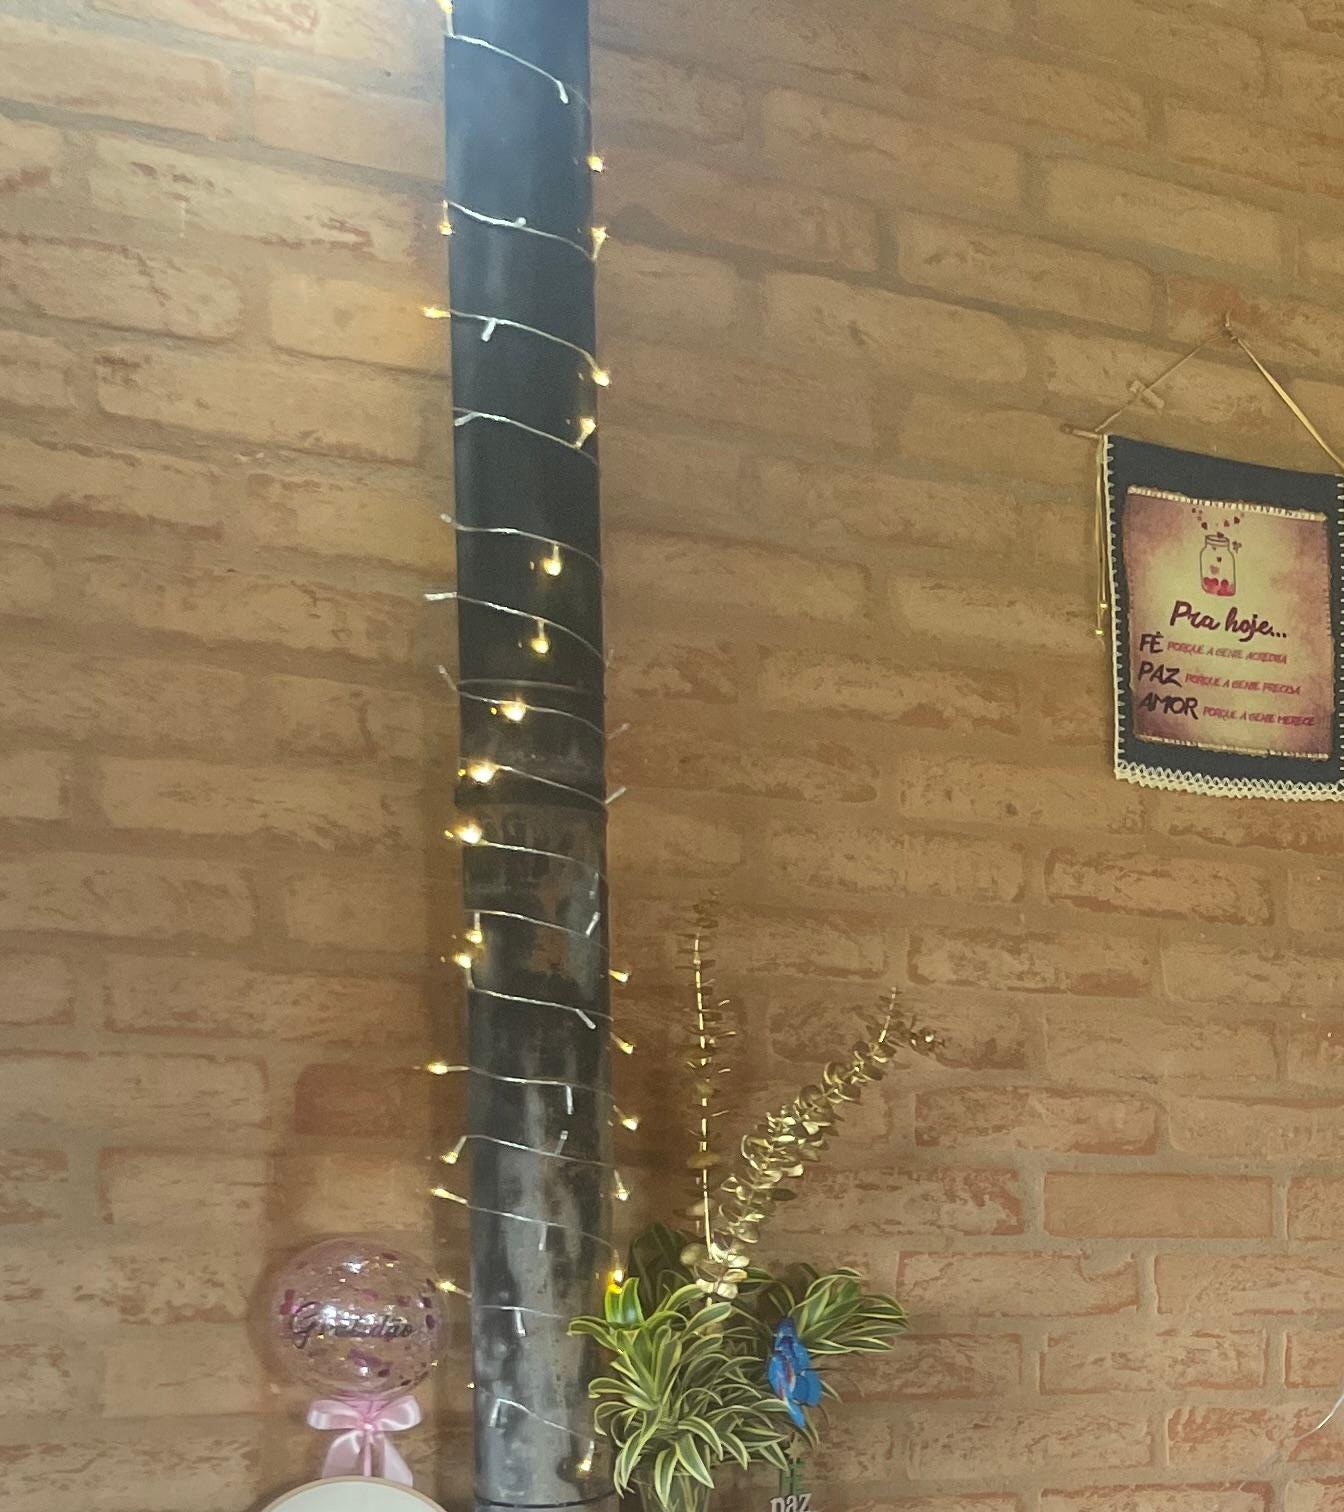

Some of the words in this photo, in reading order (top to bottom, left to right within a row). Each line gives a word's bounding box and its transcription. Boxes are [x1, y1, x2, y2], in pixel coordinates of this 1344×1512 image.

[1170, 600, 1221, 630] Pra
[1225, 606, 1287, 642] hoje...
[1140, 631, 1164, 653] FÉ
[1138, 661, 1182, 687] PAZ
[1138, 692, 1198, 720] AMOR
